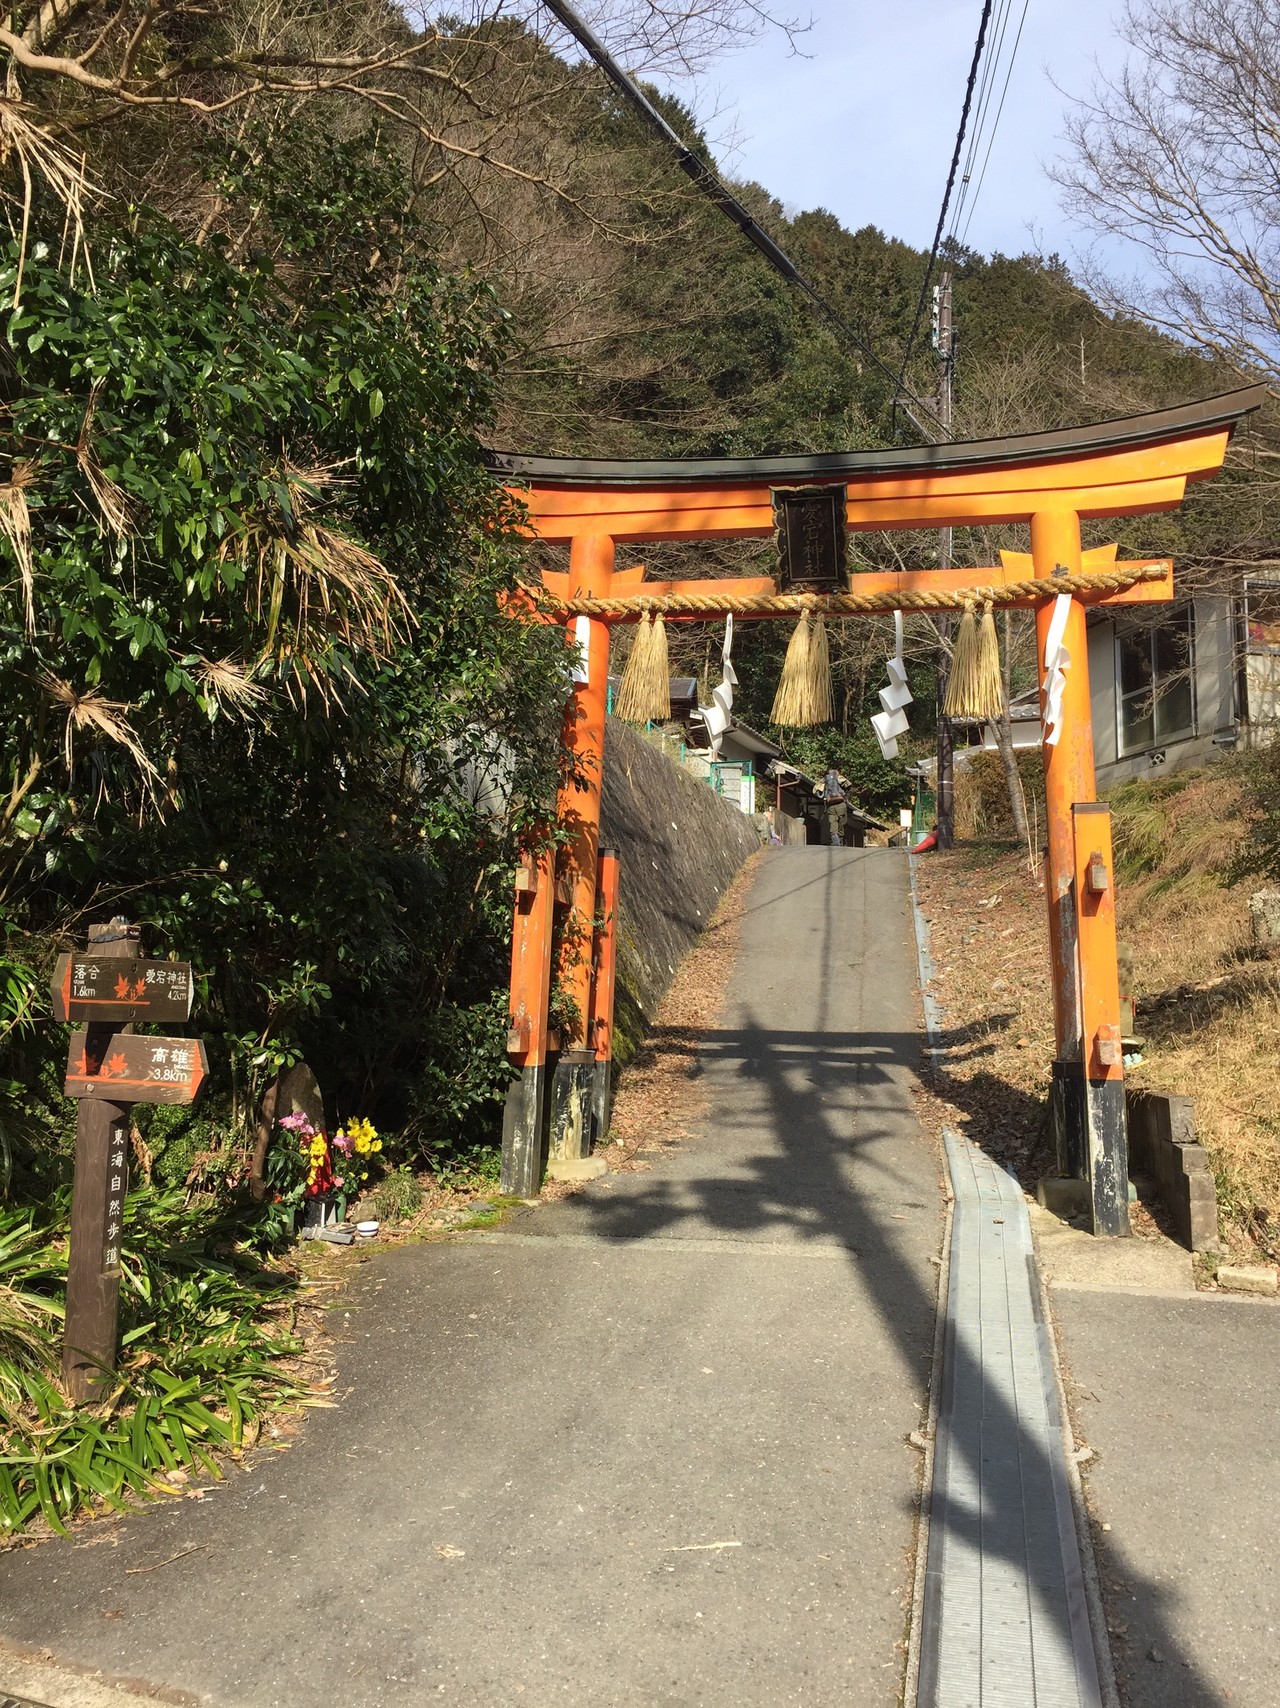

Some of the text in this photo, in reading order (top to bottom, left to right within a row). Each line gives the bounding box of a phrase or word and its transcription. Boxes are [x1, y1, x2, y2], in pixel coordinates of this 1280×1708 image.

[801, 501, 825, 577] 愛宕神社
[74, 964, 100, 980] 落合
[145, 968, 187, 985] 愛宕神社
[73, 985, 96, 997] 1.6km
[151, 1046, 189, 1064] 高雄
[153, 1068, 188, 1082] 3.8km
[105, 1128, 125, 1265] 東海自然歩道
